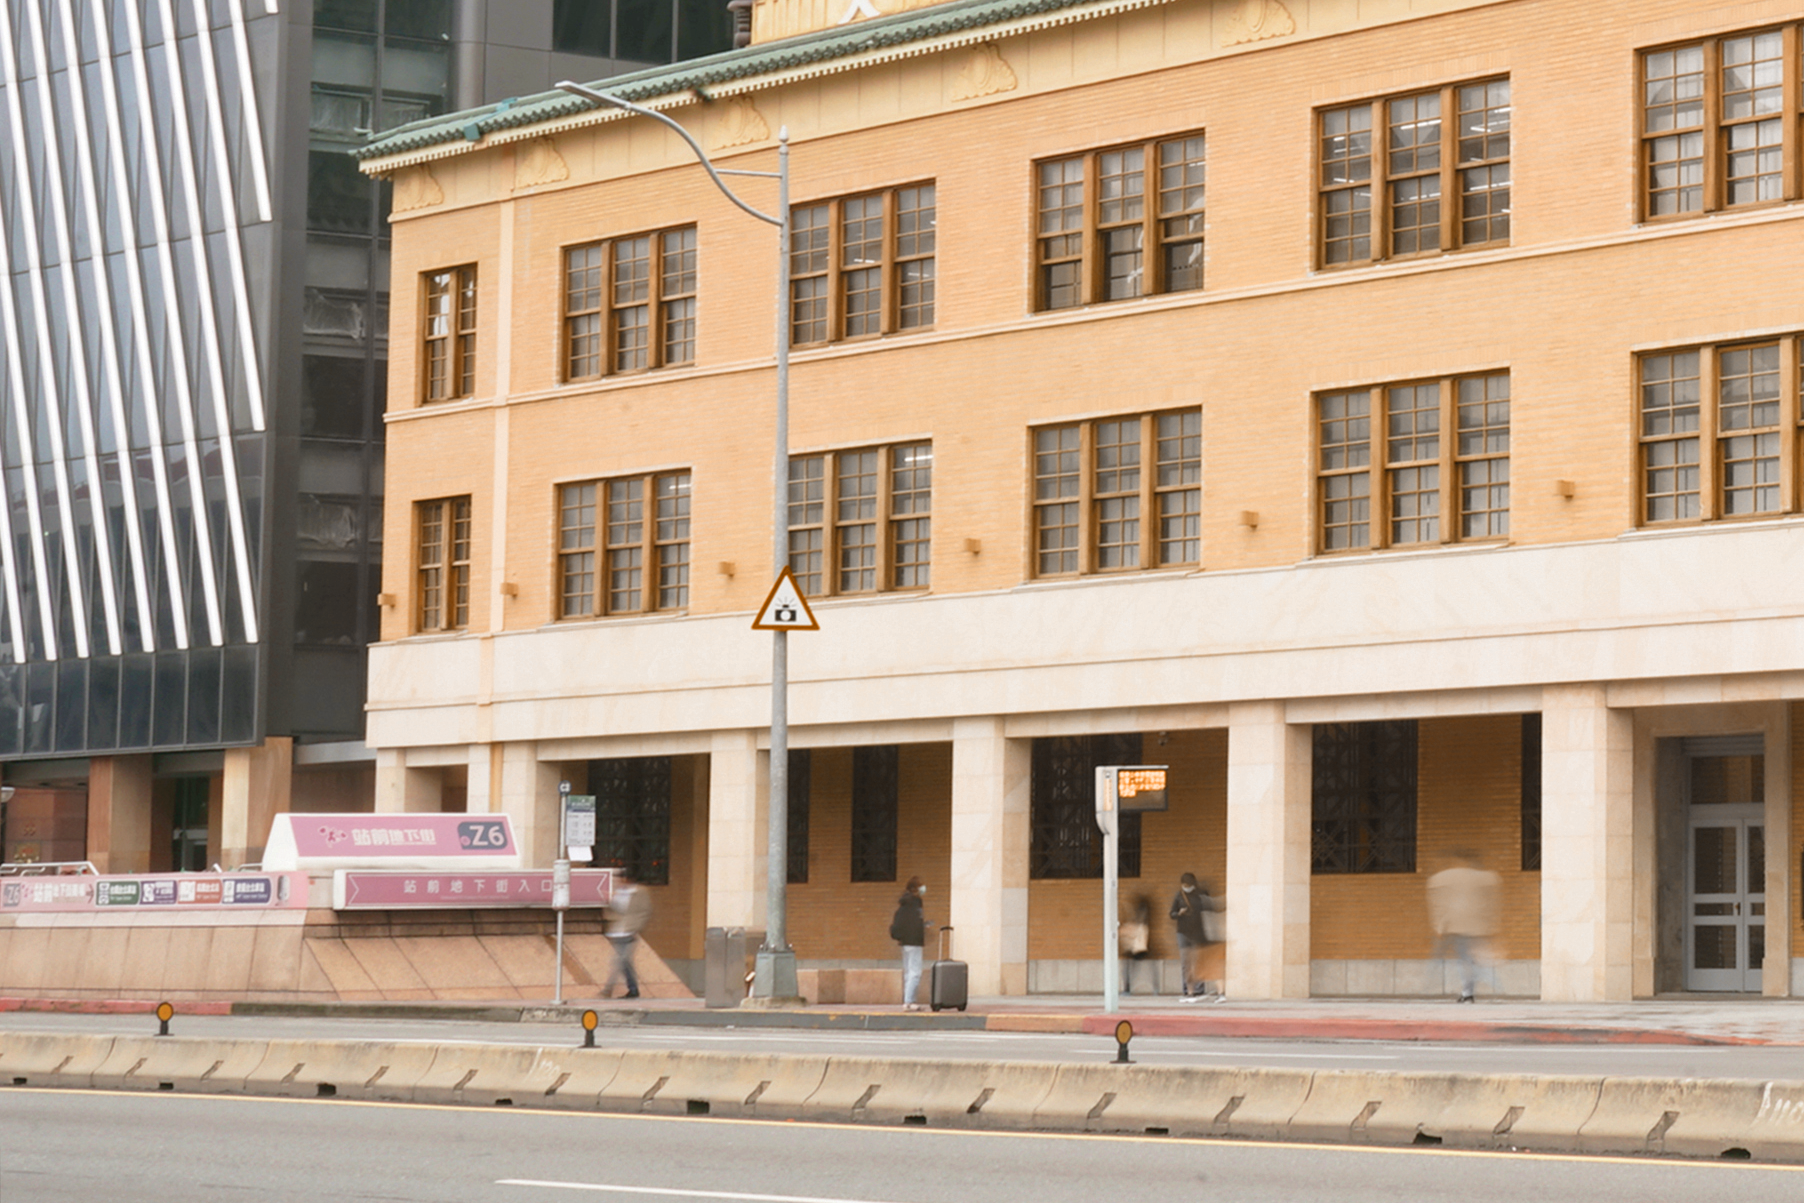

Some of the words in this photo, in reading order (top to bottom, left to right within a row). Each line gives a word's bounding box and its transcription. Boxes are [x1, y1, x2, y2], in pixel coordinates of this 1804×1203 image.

[469, 825, 505, 846] Z6
[404, 879, 552, 894] 站前地下街入口
